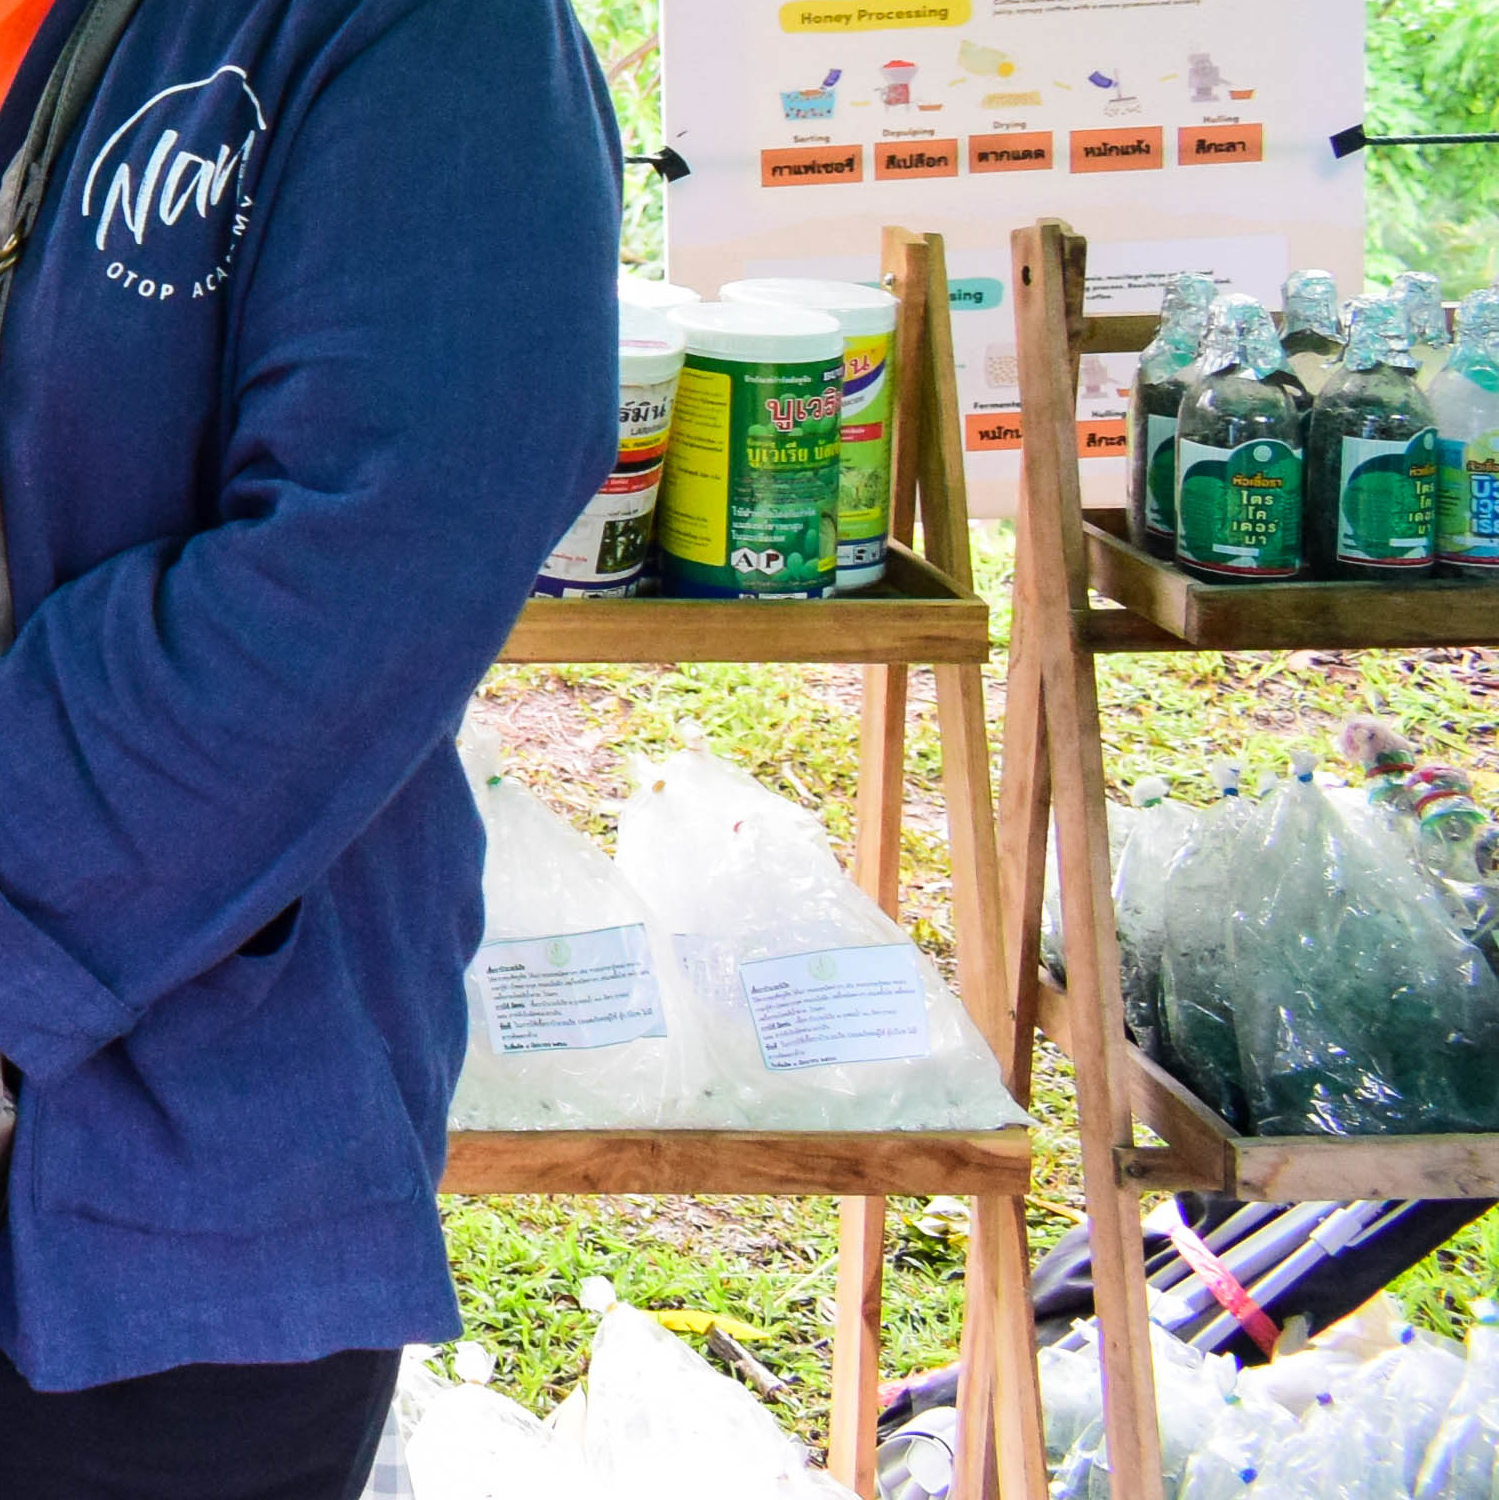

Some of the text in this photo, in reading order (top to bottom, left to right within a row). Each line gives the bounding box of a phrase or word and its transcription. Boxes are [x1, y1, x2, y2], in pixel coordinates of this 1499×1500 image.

[800, 1, 950, 28] Honey Processing
[976, 143, 1046, 164] ตากแดด
[1194, 135, 1247, 156] สีกะลา
[883, 148, 949, 171] สีเปลือก
[94, 129, 257, 252] Nan
[106, 261, 175, 301] OTOP
[949, 288, 985, 304] sing
